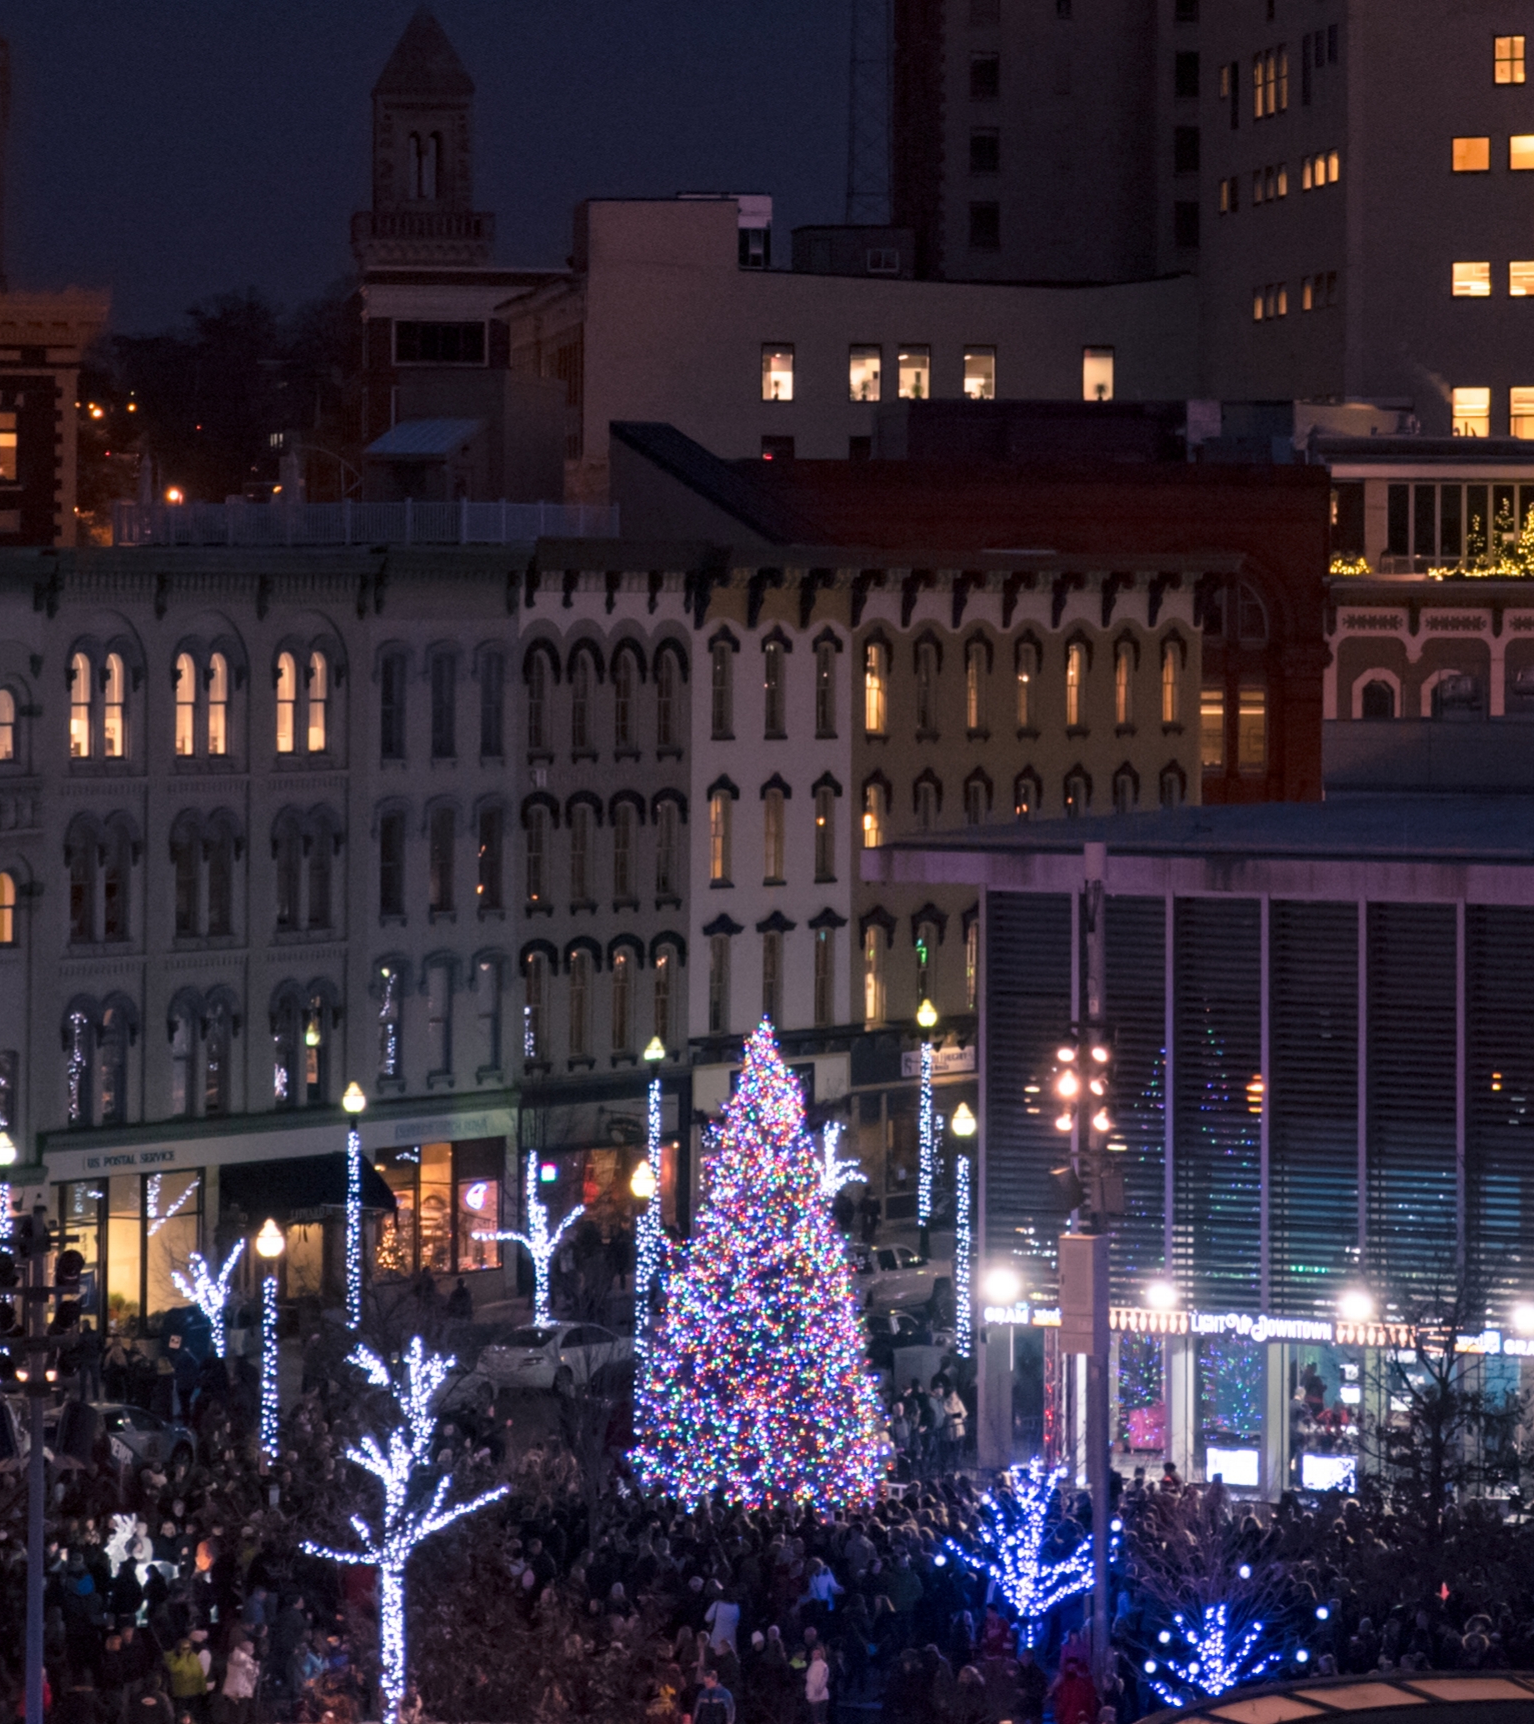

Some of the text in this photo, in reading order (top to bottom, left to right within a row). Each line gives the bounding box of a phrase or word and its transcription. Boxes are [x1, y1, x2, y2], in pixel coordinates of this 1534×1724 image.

[104, 1154, 136, 1167] POSTAL
[140, 1150, 175, 1163] SERVICE
[984, 1306, 1029, 1324] GRAM
[1191, 1313, 1226, 1333] LIGHT
[1250, 1315, 1332, 1342] DOWNTOWN
